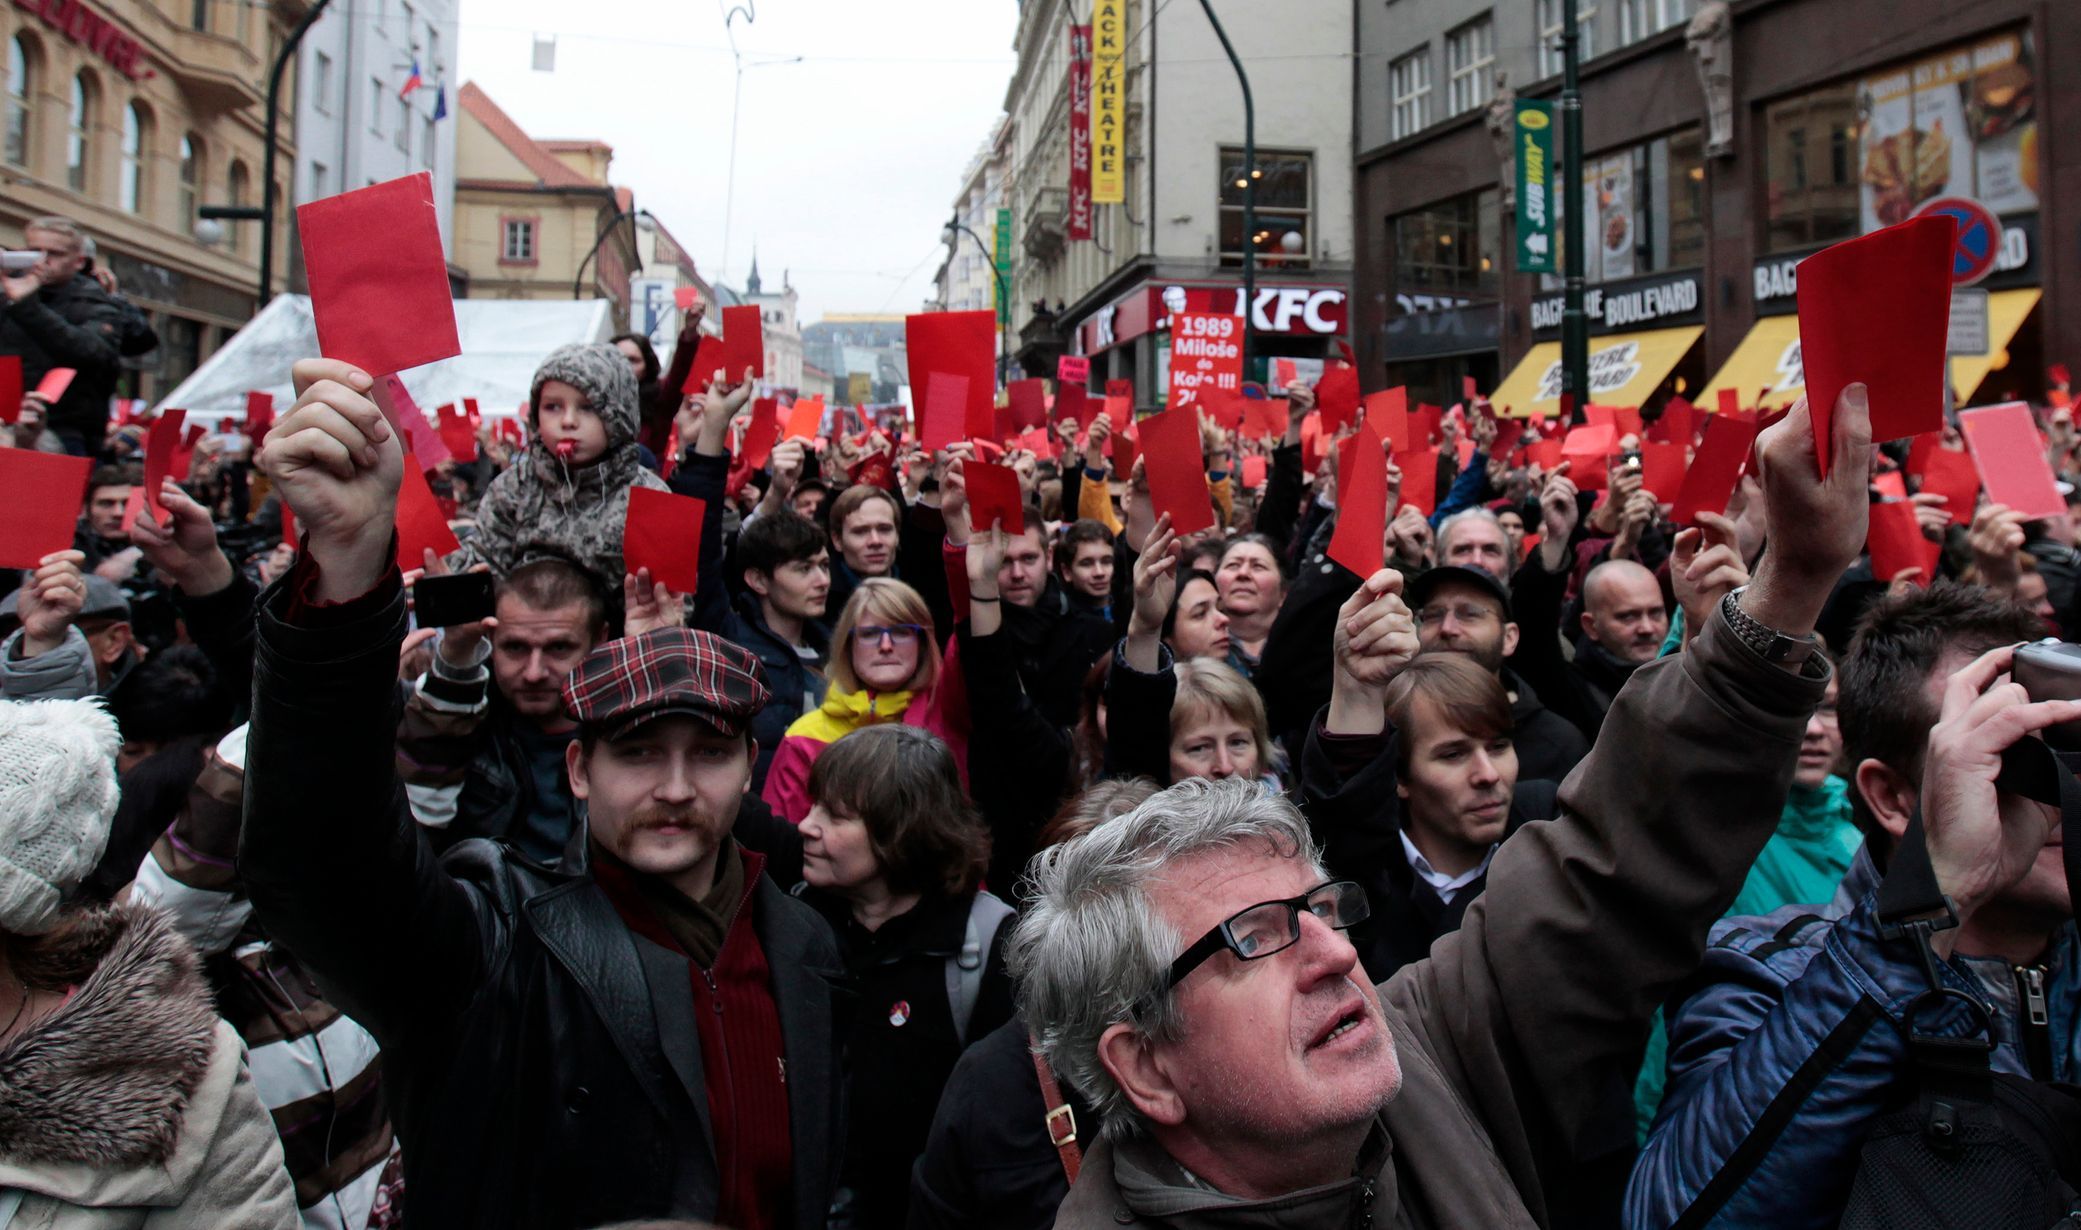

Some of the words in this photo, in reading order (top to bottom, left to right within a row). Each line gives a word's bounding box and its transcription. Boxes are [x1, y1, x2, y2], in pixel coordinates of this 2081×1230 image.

[1101, 0, 1116, 48] ACK
[1101, 66, 1116, 173] THEATRE
[1074, 127, 1088, 171] KFC
[1524, 133, 1546, 228] SUBWAY
[1074, 187, 1087, 229] KFC
[1234, 287, 1341, 333] KFC
[1605, 279, 1698, 327] BOULEVARD
[1175, 337, 1238, 359] Miloše
[1181, 316, 1233, 338] 1989
[1196, 358, 1213, 370] do
[1218, 373, 1237, 390] !!!
